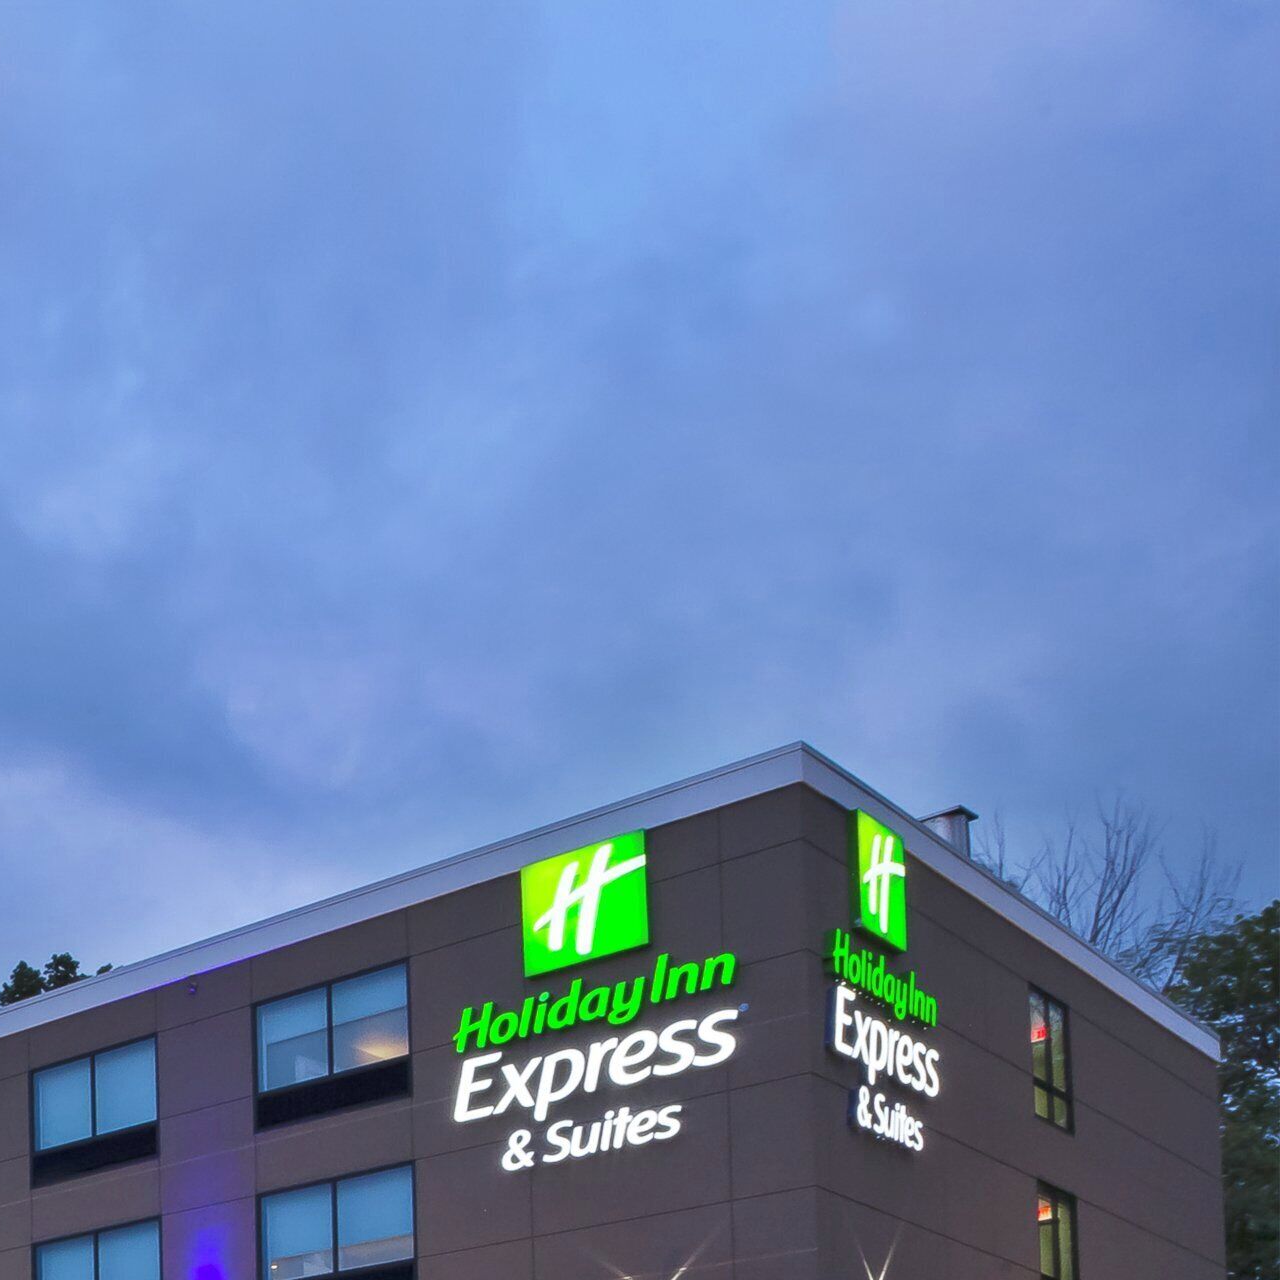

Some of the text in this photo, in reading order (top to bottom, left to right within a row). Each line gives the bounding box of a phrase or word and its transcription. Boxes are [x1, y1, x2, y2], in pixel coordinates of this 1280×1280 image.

[453, 953, 736, 1053] Holiday Inn
[833, 928, 937, 1027] Holiday Inn
[453, 1009, 739, 1122] Express
[834, 984, 940, 1098] Express
[501, 1105, 682, 1171] & Suites
[857, 1085, 924, 1151] & Suites
